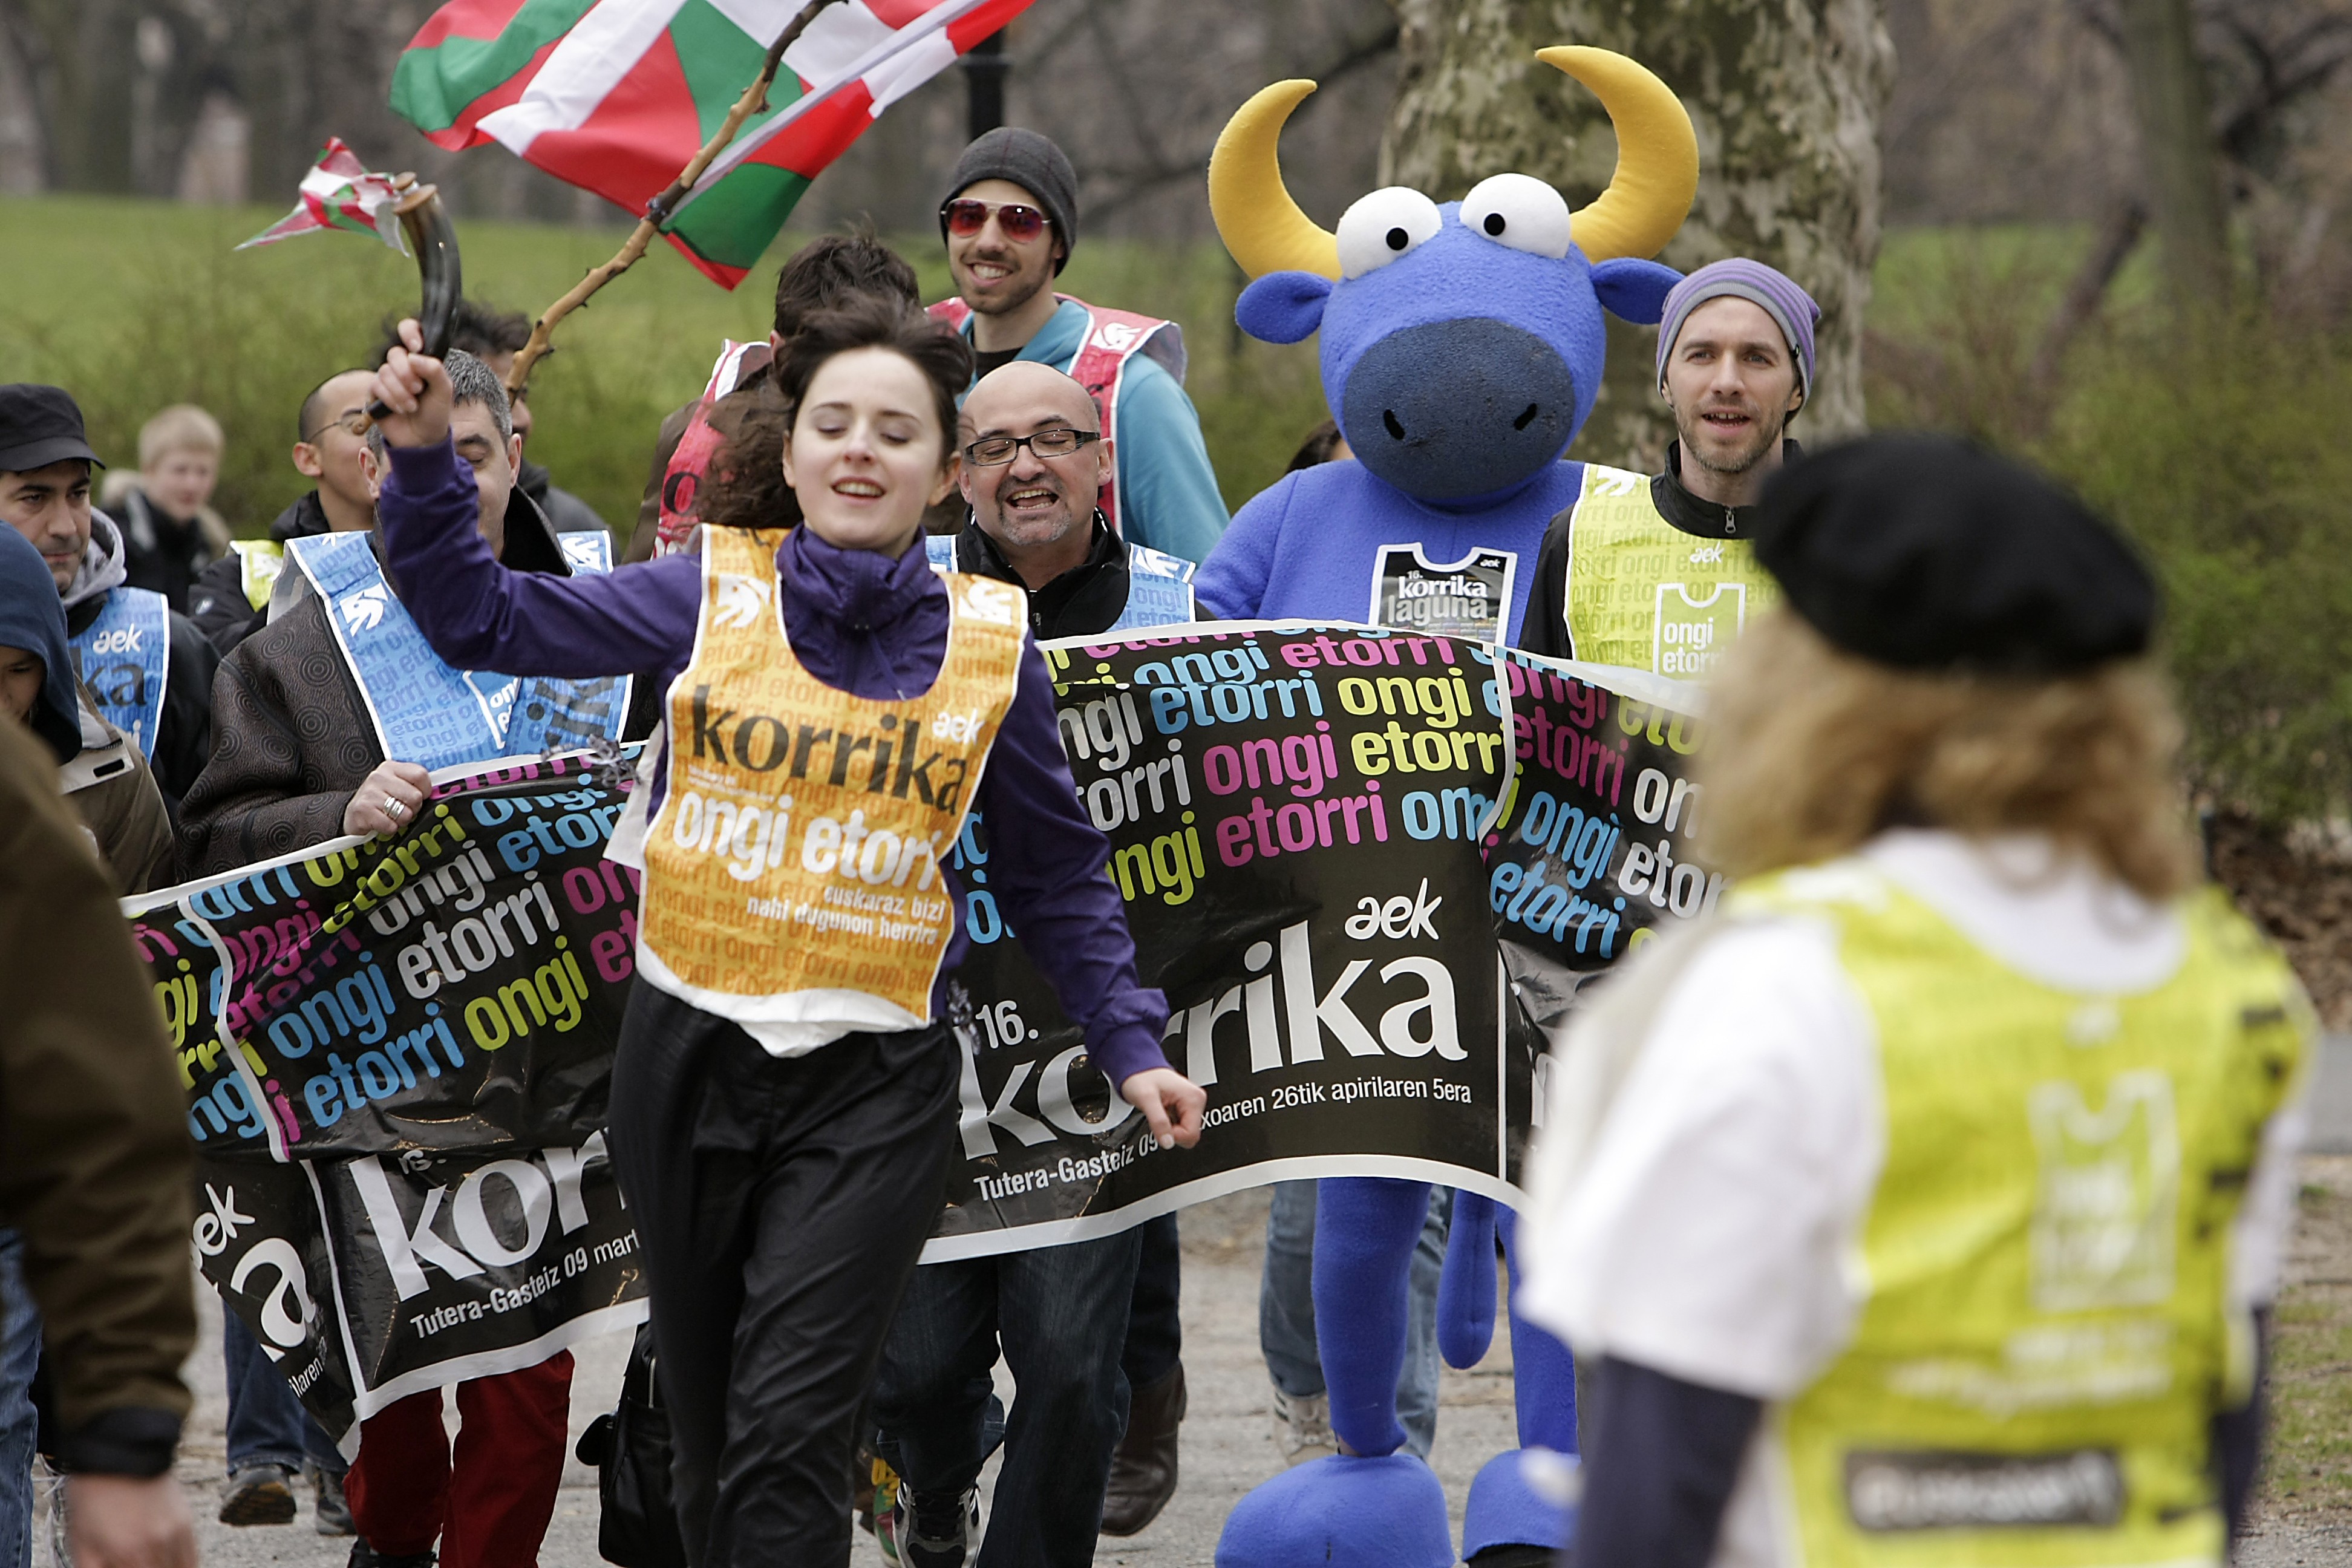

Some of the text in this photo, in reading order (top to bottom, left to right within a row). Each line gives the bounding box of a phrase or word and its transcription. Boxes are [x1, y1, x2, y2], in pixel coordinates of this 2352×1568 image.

[1399, 575, 1488, 599] korrika
[1690, 541, 1725, 564] aek
[93, 623, 143, 655] aek
[1388, 595, 1488, 627] laguna
[1663, 617, 1714, 650] ongi
[1134, 640, 1269, 685] ongi
[1280, 636, 1455, 668] etorri
[692, 684, 967, 817] korrika
[932, 708, 985, 745] aek
[1057, 683, 1143, 771] ngi
[1150, 670, 1323, 734] etorri
[1338, 667, 1472, 728] ongi
[472, 773, 607, 826] ongi
[1076, 720, 1504, 831] orri ongi etorr
[1514, 706, 1628, 806] etorri
[1634, 768, 1704, 838] on
[368, 840, 495, 935] ongi
[497, 802, 627, 872] etor
[673, 791, 793, 882] ongi
[1105, 811, 1205, 905] ngi
[1216, 780, 1388, 867] etorri
[1521, 792, 1619, 890] ongi
[746, 896, 789, 921] nahi
[794, 901, 873, 935] dugunon
[824, 885, 946, 923] euskaraz bizi
[1345, 878, 1442, 940] aek
[1490, 861, 1626, 959] etorri
[268, 951, 396, 1059] ongi
[397, 870, 560, 999] etorri
[562, 859, 641, 914] on
[304, 1002, 465, 1128] etorri
[464, 935, 589, 1051] ongi
[975, 1000, 1039, 1058] 16.
[973, 1145, 1134, 1201] Tutera-Gasteiz
[1199, 1094, 1265, 1131] xoaren
[1272, 1082, 1326, 1110] 26tik
[1331, 1076, 1428, 1105] apirilaren
[1433, 1078, 1472, 1105] 5era
[189, 1182, 255, 1269] ek
[410, 1267, 560, 1339] Tutera-Gasteiz
[564, 1246, 589, 1279] 09
[288, 1357, 323, 1399] ilaren
